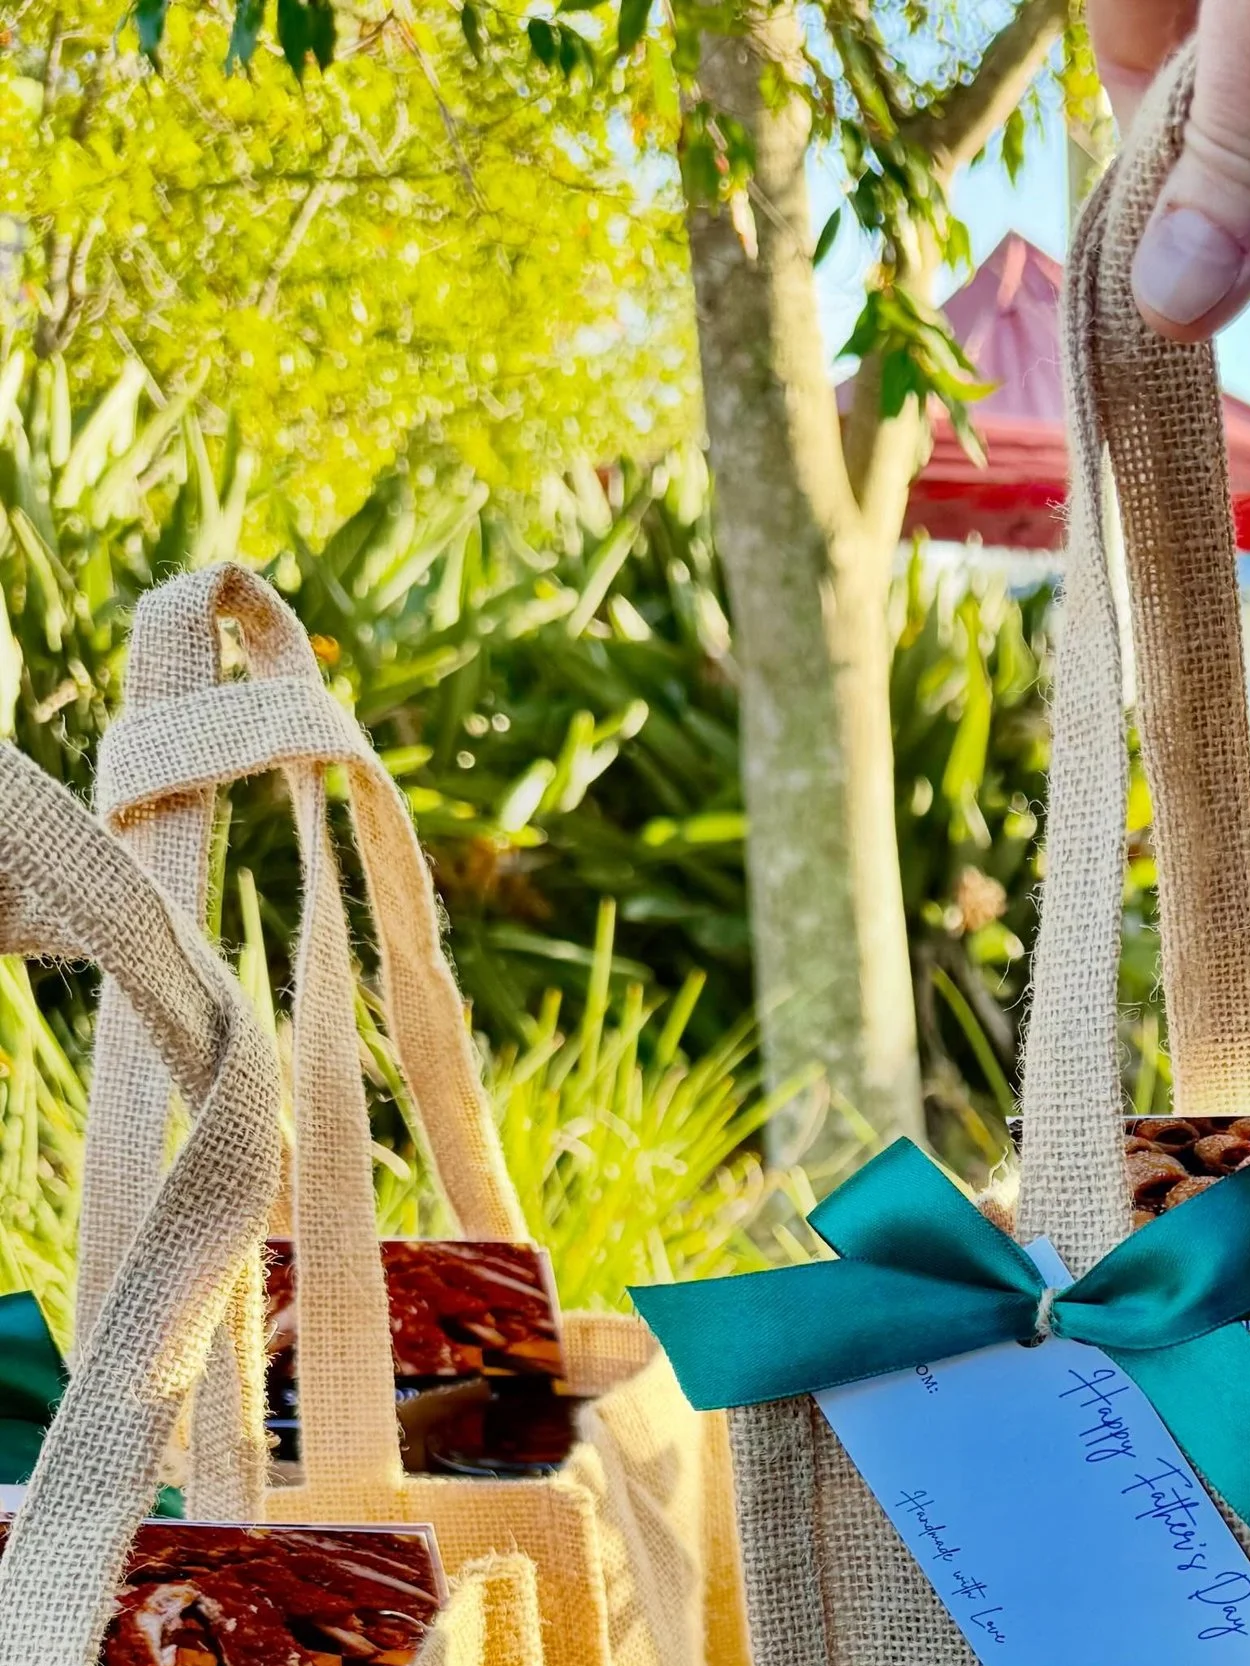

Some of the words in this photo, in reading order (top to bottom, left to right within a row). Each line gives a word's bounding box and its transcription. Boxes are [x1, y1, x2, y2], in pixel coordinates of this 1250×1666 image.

[915, 1363, 938, 1394] OM:
[1059, 1369, 1136, 1462] Happy
[1121, 1457, 1207, 1571] Father's
[895, 1490, 961, 1563] Handmade
[952, 1569, 986, 1600] with
[970, 1607, 1004, 1644] Love
